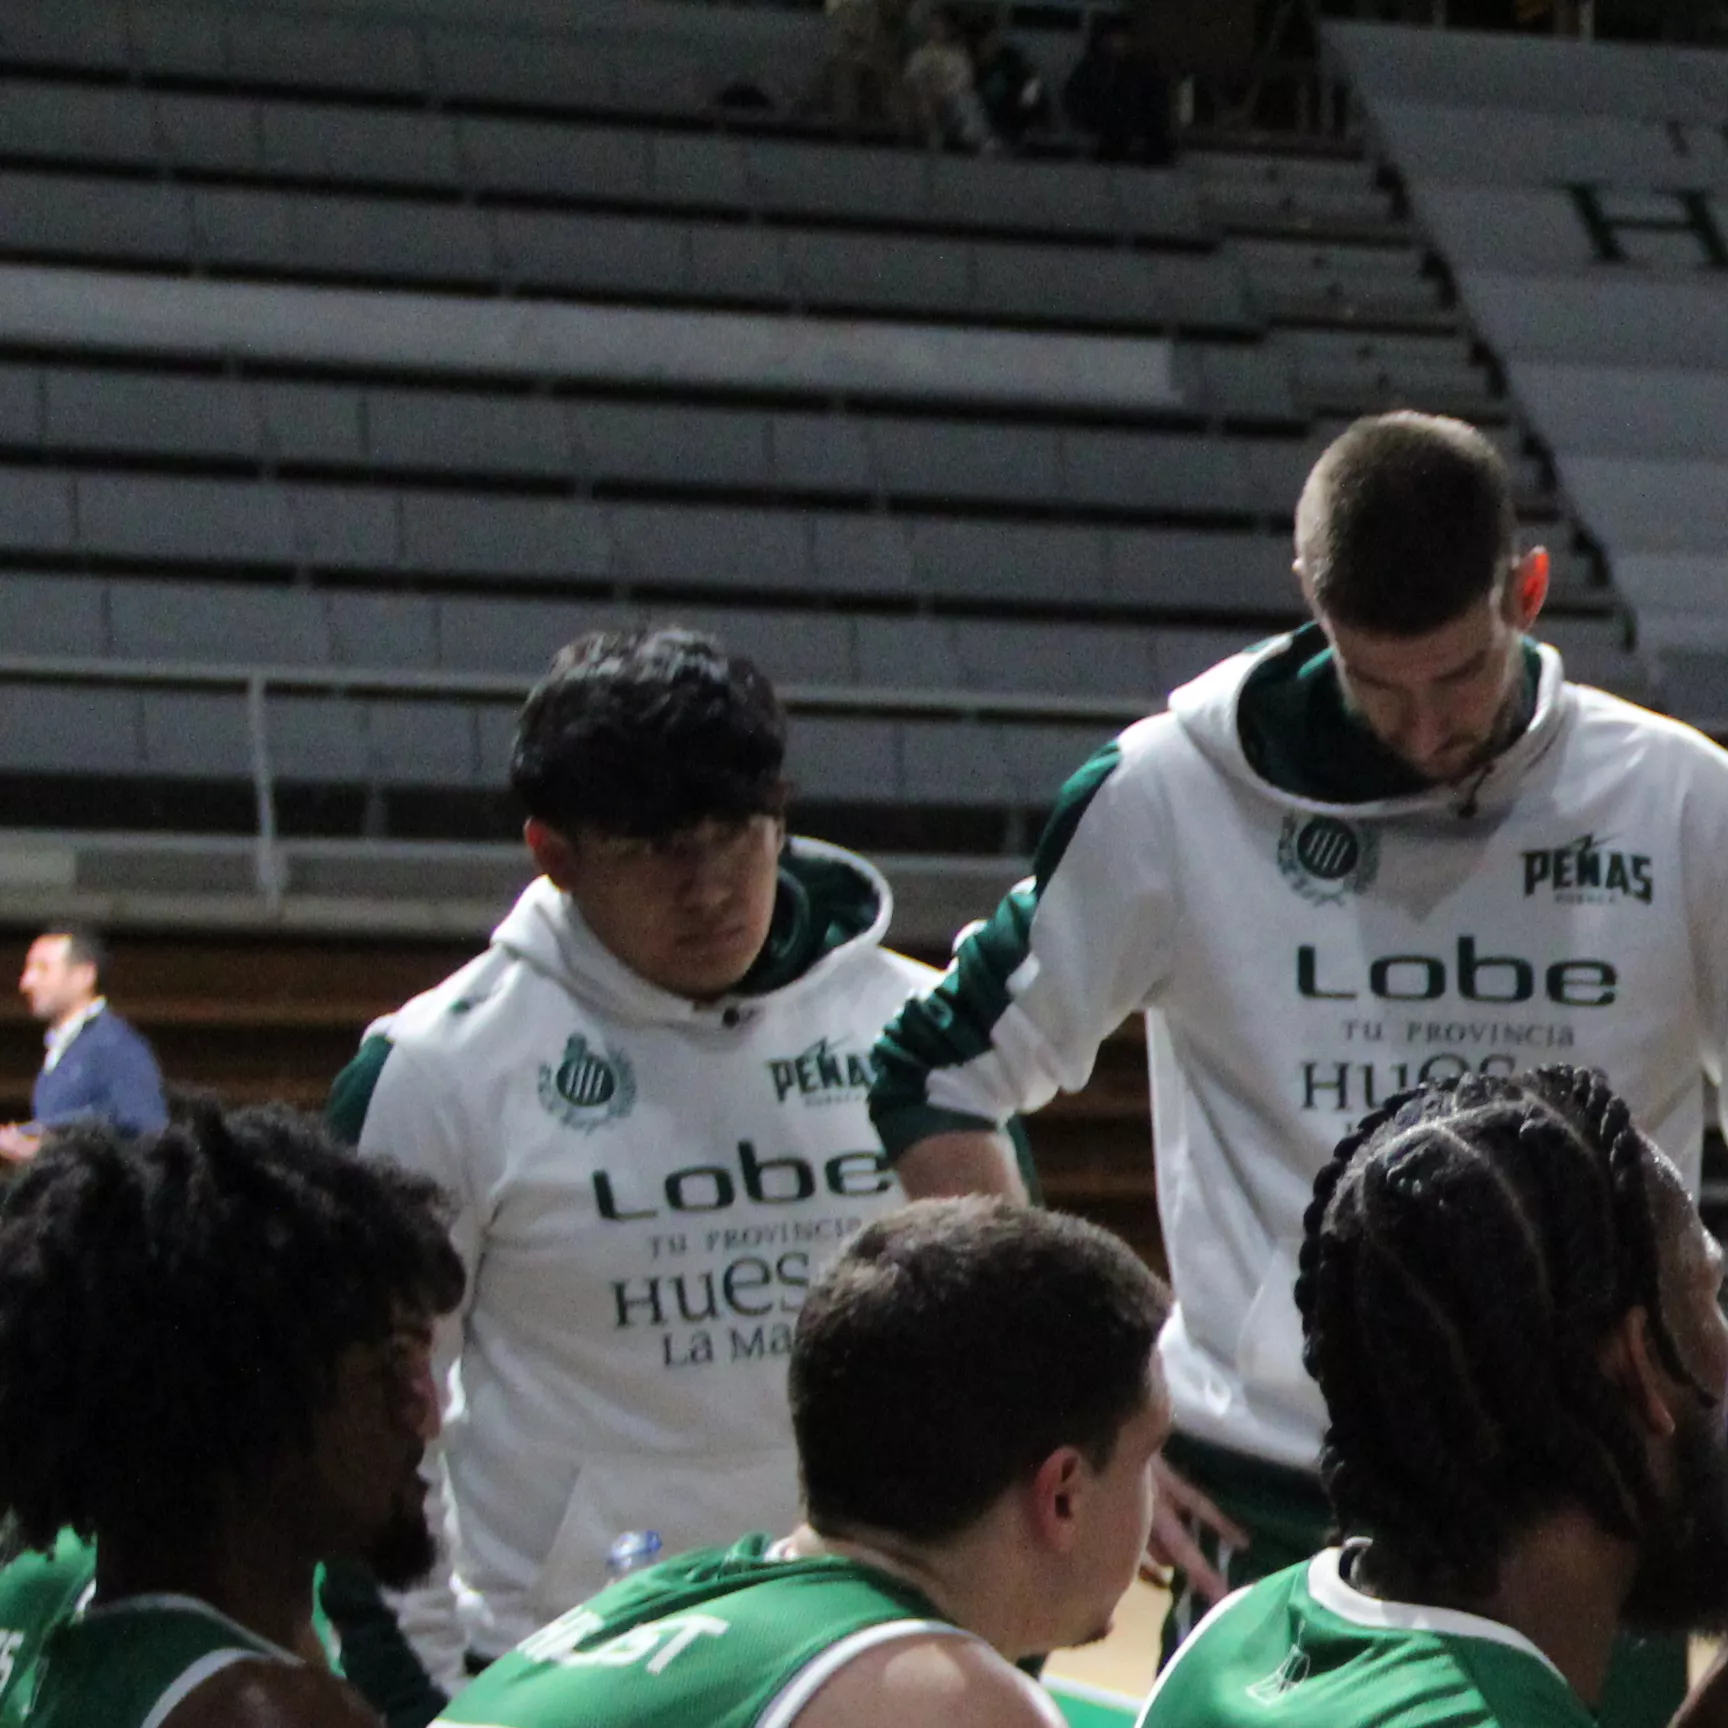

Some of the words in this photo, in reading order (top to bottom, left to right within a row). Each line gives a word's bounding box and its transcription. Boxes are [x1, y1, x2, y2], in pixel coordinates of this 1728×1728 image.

[1297, 935, 1619, 1007] Lobe
[766, 1036, 876, 1103] PEÑA
[591, 1140, 893, 1222] Lobe
[610, 1251, 809, 1329] Hues
